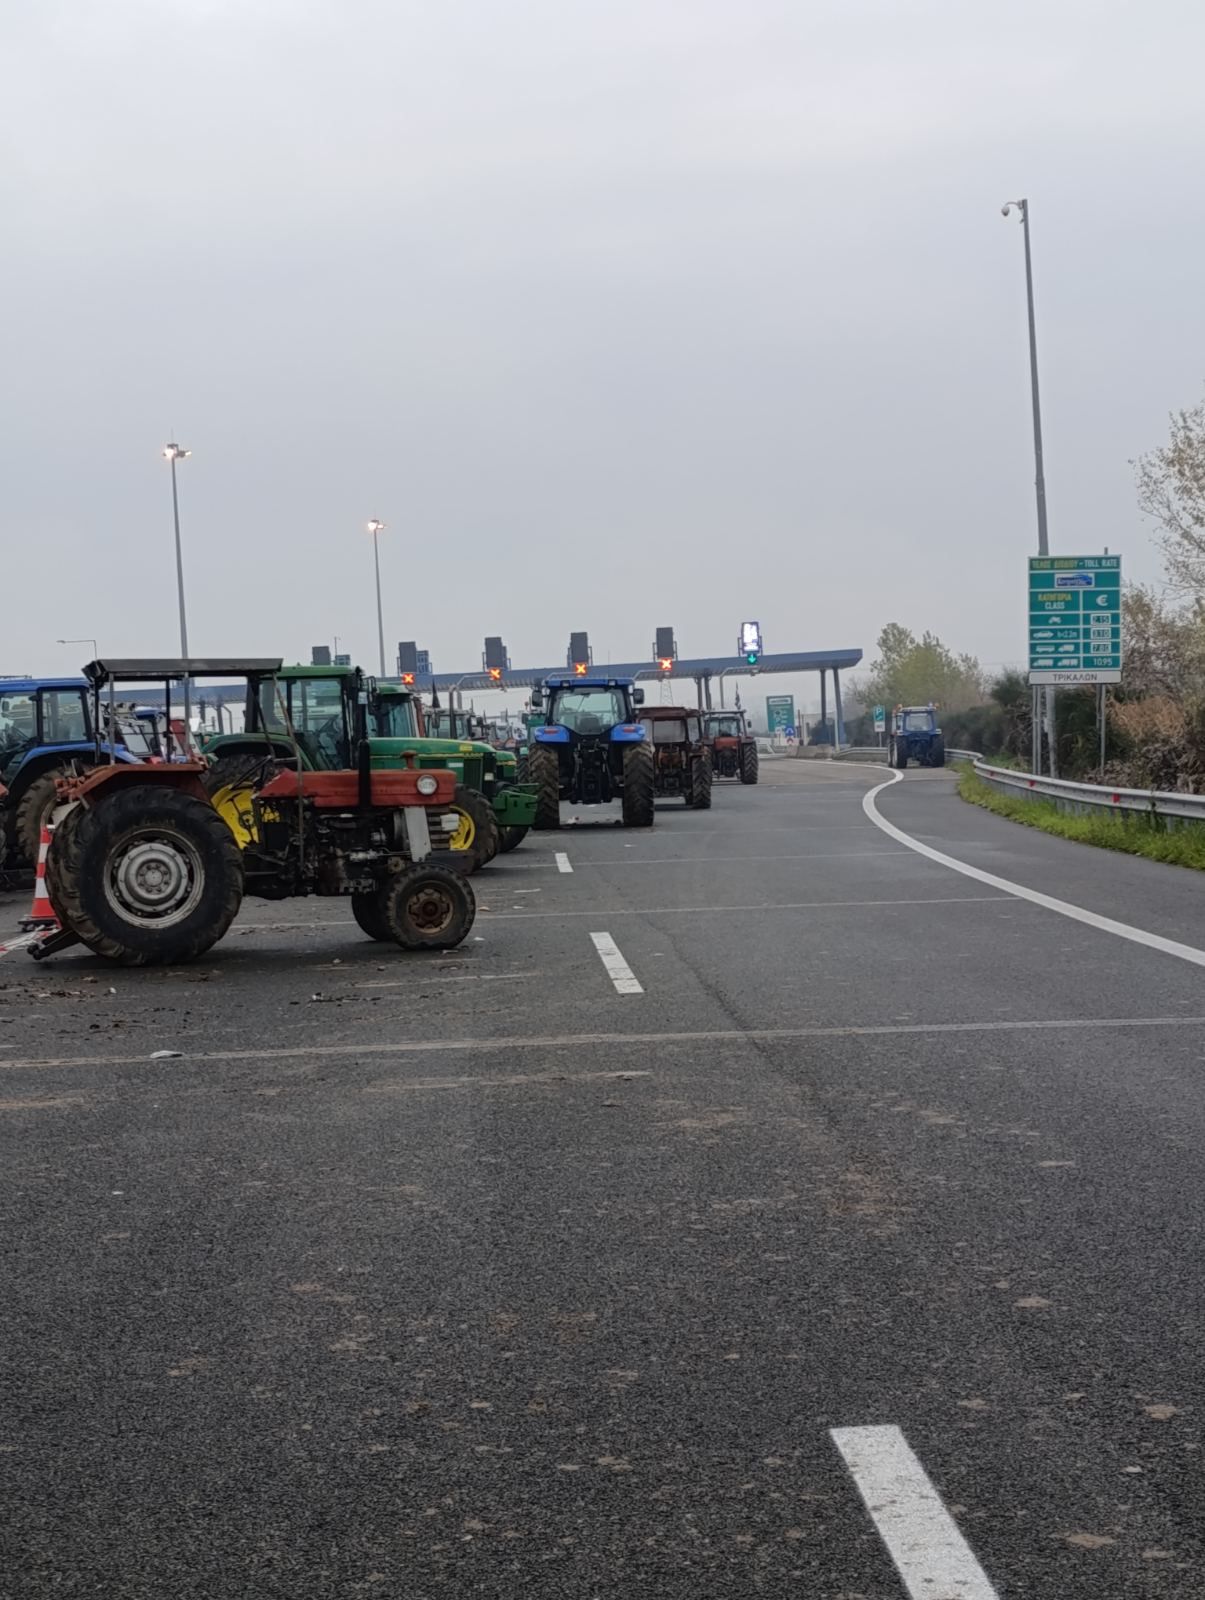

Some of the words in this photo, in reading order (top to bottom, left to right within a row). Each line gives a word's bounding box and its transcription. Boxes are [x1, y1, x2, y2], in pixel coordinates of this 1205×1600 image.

[1084, 559, 1099, 568] TOLL
[1096, 594, 1109, 606] €
[1044, 601, 1065, 610] CLASS
[1052, 673, 1098, 682] ΤΡΙΚΑΛΩΝ
